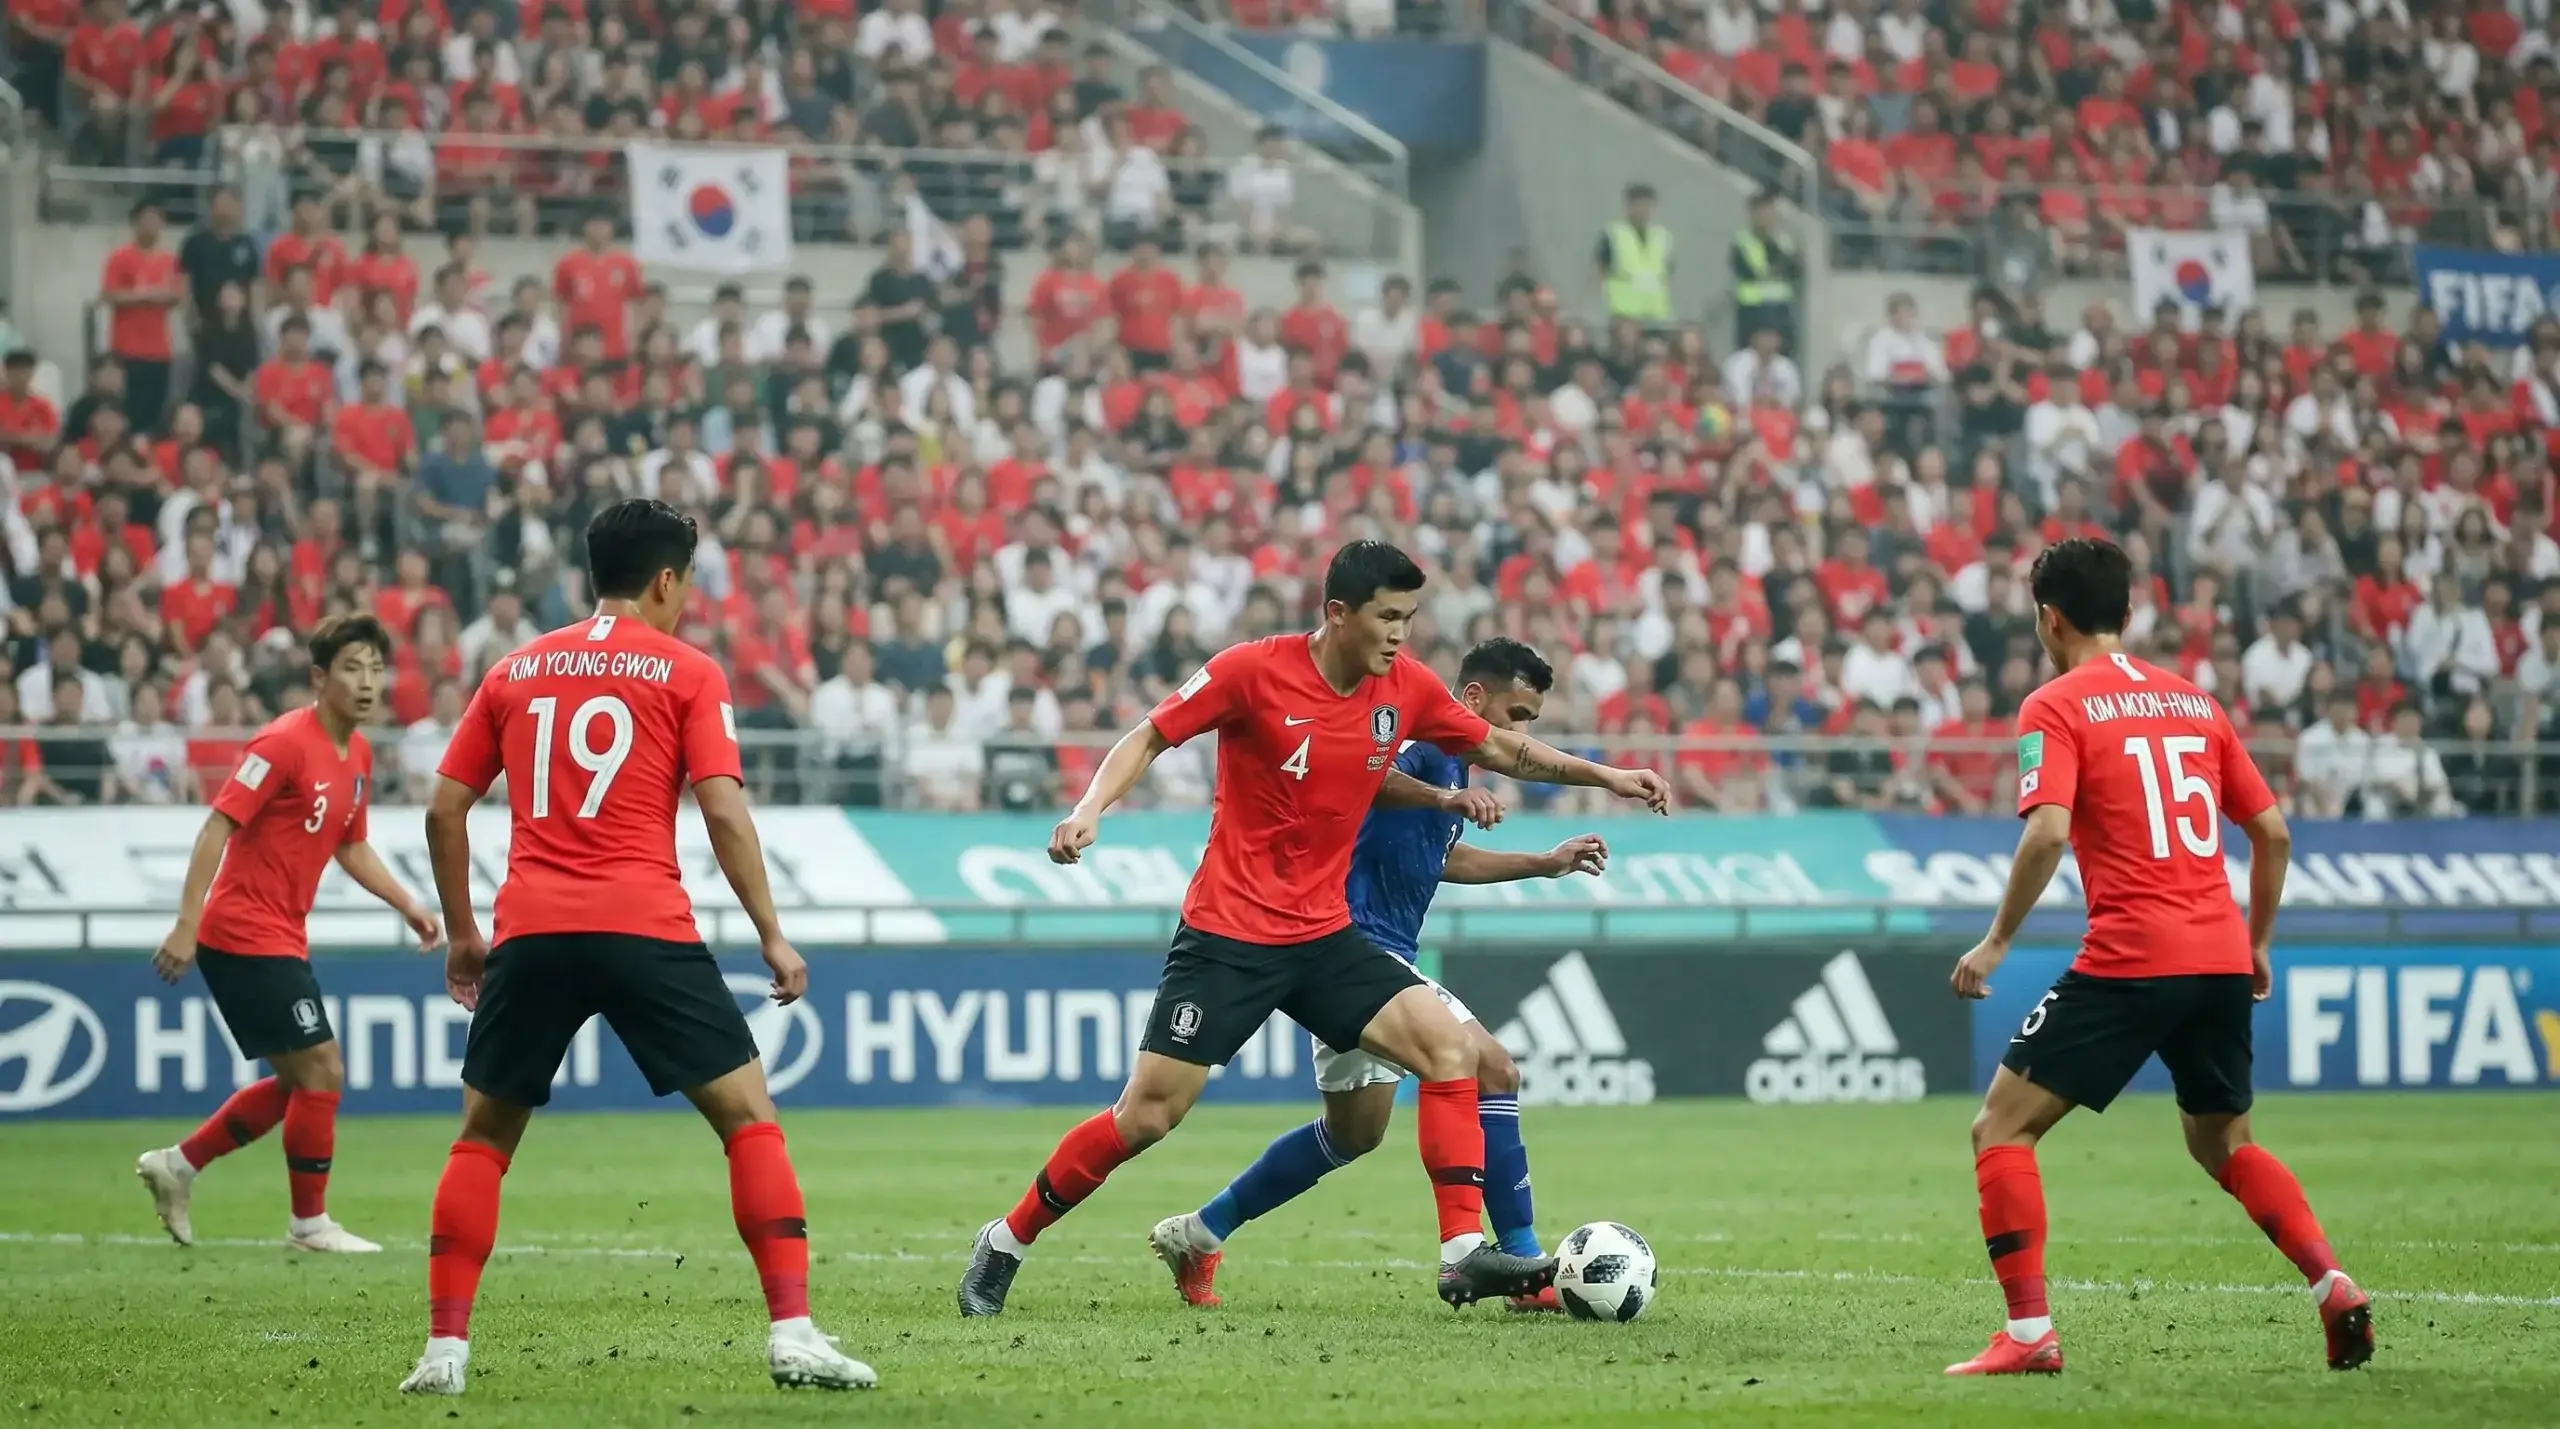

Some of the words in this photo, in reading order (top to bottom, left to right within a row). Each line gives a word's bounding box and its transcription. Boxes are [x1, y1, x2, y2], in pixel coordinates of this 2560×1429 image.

[2429, 270, 2545, 332] FIFA
[508, 654, 541, 682] KIM
[545, 651, 607, 677] YOUNG
[611, 652, 673, 684] GWON
[2082, 694, 2119, 723] KIM
[2115, 691, 2214, 721] MOON-HWAN
[526, 695, 634, 819] 19
[1280, 734, 1311, 781] 4
[305, 795, 328, 833] 3
[2124, 736, 2219, 859] 15
[2021, 990, 2059, 1036] 5
[2287, 967, 2538, 1083] FIFA
[1517, 1053, 1656, 1106] didas
[1745, 1050, 1926, 1104] adidas
